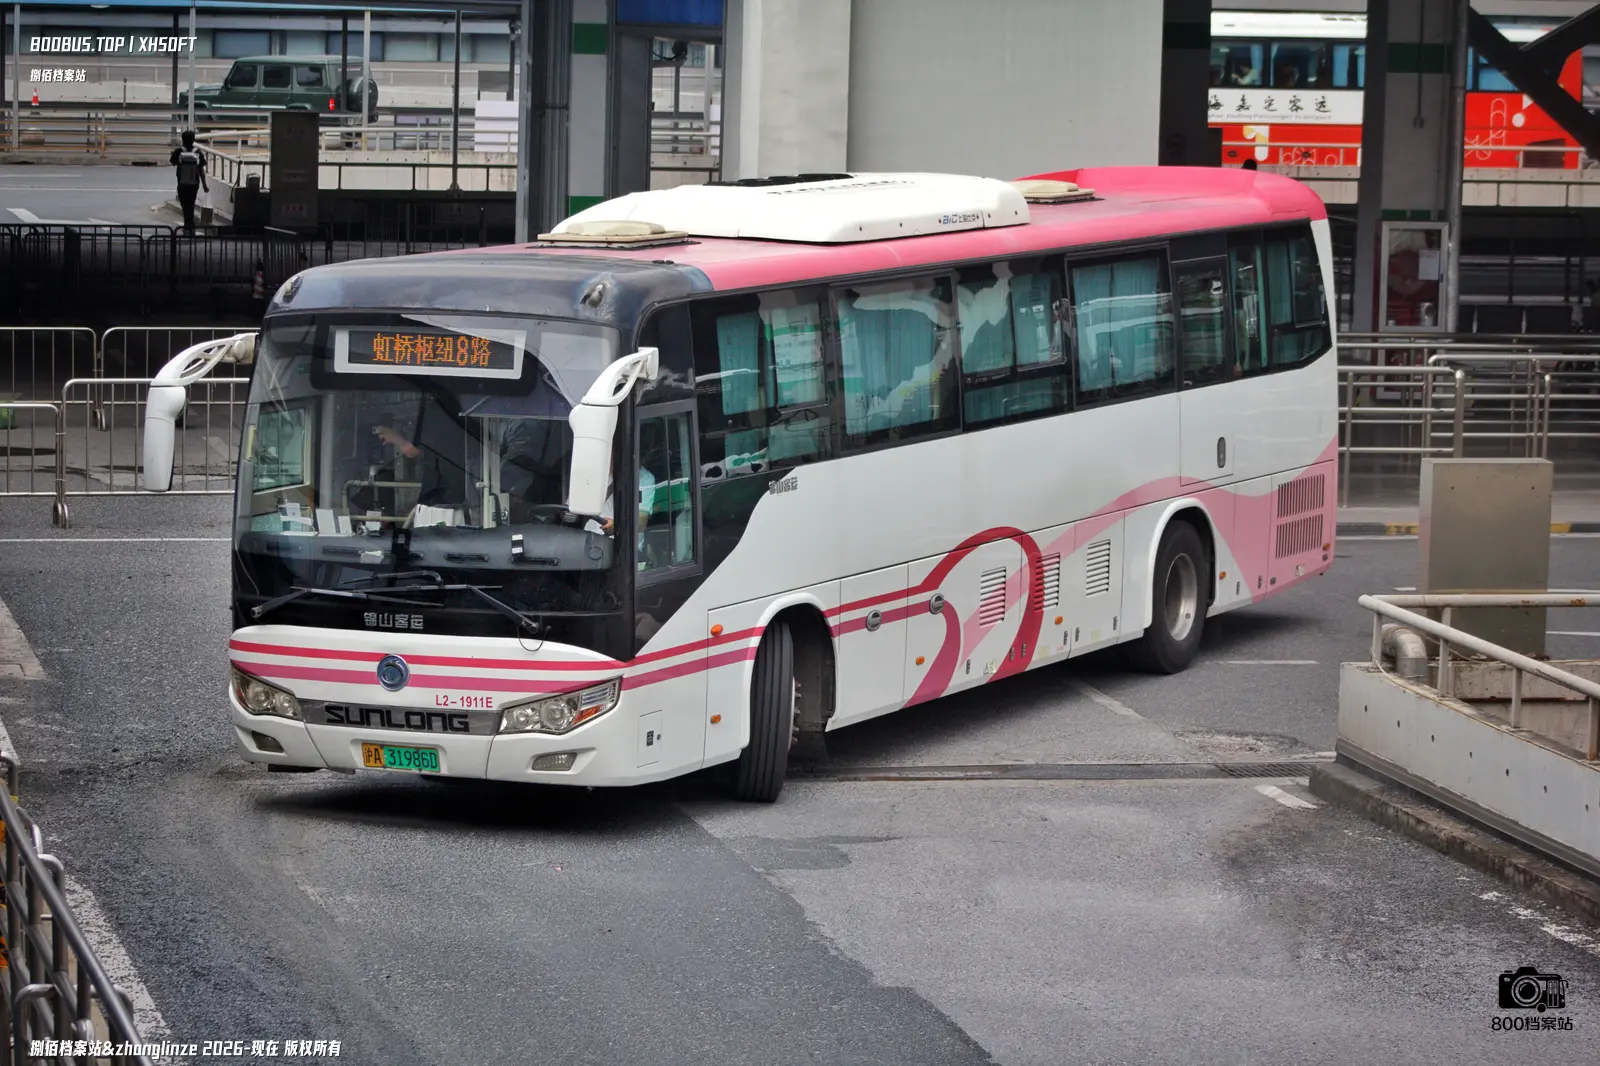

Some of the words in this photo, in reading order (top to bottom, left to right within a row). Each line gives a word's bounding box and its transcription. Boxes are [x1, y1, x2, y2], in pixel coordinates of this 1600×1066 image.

[373, 332, 492, 367] 虹桥枢纽8路
[435, 694, 494, 709] L2-1911E
[324, 704, 470, 733] SUNLONG
